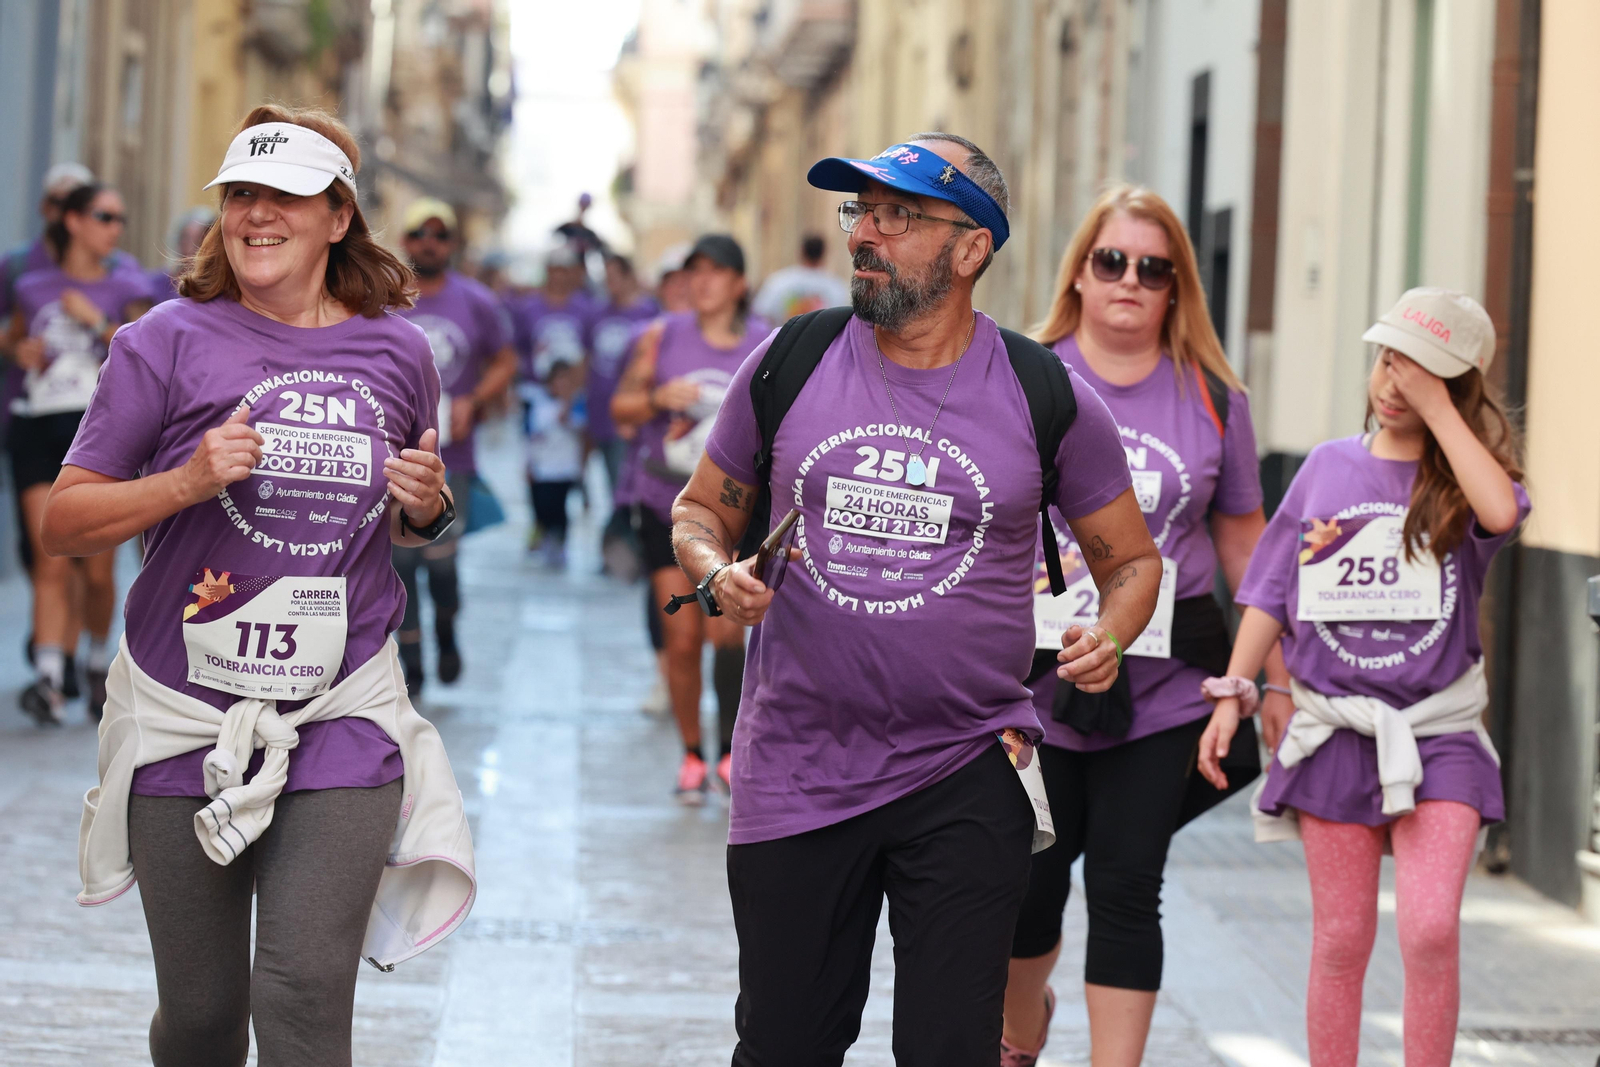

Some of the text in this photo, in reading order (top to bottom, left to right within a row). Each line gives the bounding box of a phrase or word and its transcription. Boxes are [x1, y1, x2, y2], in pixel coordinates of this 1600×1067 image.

[1402, 306, 1452, 344] LALIGA
[229, 369, 348, 418] TERNACIONAL
[279, 390, 356, 427] 25N
[260, 426, 368, 446] SERVICIO DE EMERGENCIAS
[272, 437, 355, 459] 24 HORAS
[798, 423, 933, 477] INTERNACIONAL
[258, 455, 365, 479] 900 21 21 30
[937, 438, 991, 500] CONTRA
[275, 487, 358, 505] Ayuntamiento de Cádiz
[792, 478, 805, 507] DÍA
[831, 481, 948, 508] SERVICIO DE EMERGENCIAS
[843, 494, 929, 520] 24 HORAS
[980, 501, 995, 524] LA
[217, 487, 344, 556] HACIA LAS MUJER
[828, 509, 940, 538] 900 21 21 30
[845, 542, 932, 561] Ayuntamiento de Cádiz
[931, 524, 990, 596] VIOLENCIA
[1337, 557, 1400, 586] 258
[292, 589, 340, 599] CARRERA
[826, 587, 859, 611] LAS
[864, 593, 925, 615] HACIA
[1318, 590, 1421, 601] TOLERANCIA CERO
[235, 621, 298, 661] 113
[204, 654, 324, 677] TOLERANCIA CERO
